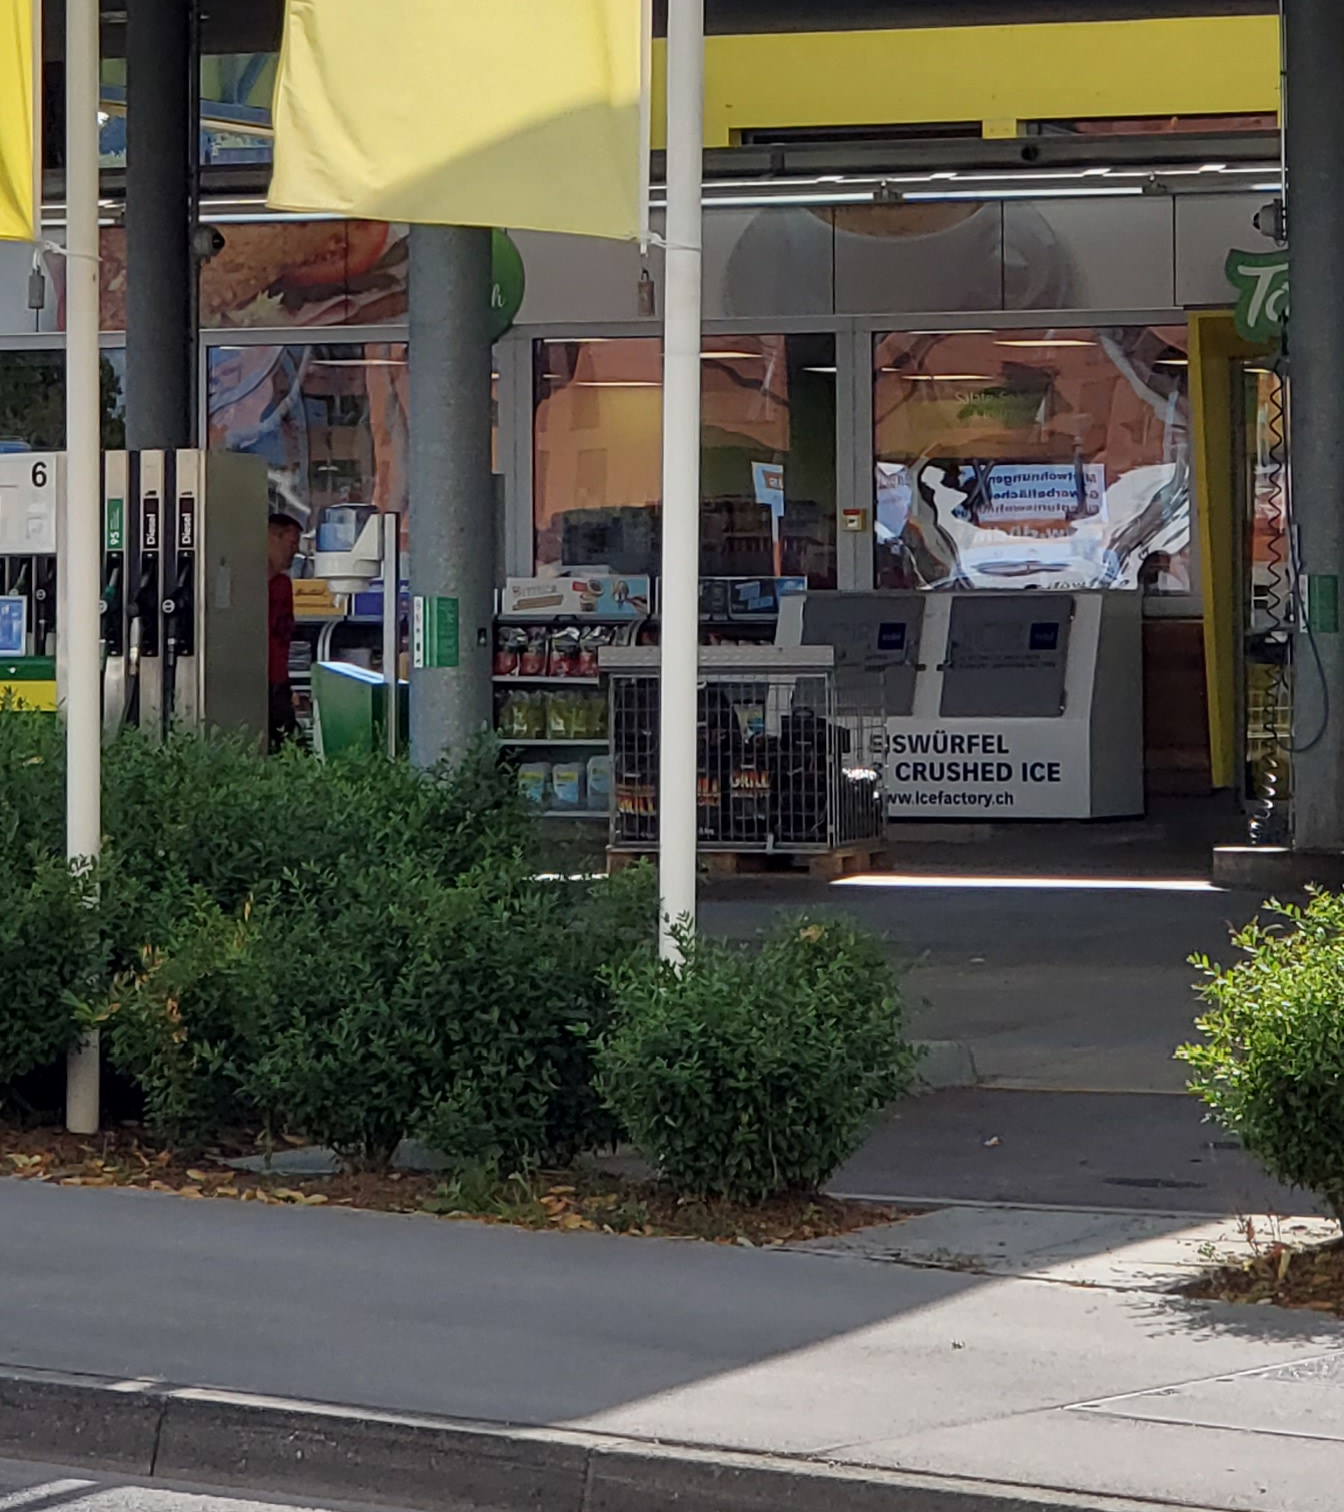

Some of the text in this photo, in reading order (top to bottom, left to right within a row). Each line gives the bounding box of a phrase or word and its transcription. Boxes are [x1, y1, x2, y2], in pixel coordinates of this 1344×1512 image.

[31, 461, 47, 487] 6
[110, 531, 120, 545] 95
[146, 513, 156, 545] Diesel
[182, 513, 191, 544] Diesel
[895, 762, 1013, 782] CRUSHED
[1021, 763, 1062, 782] ICE
